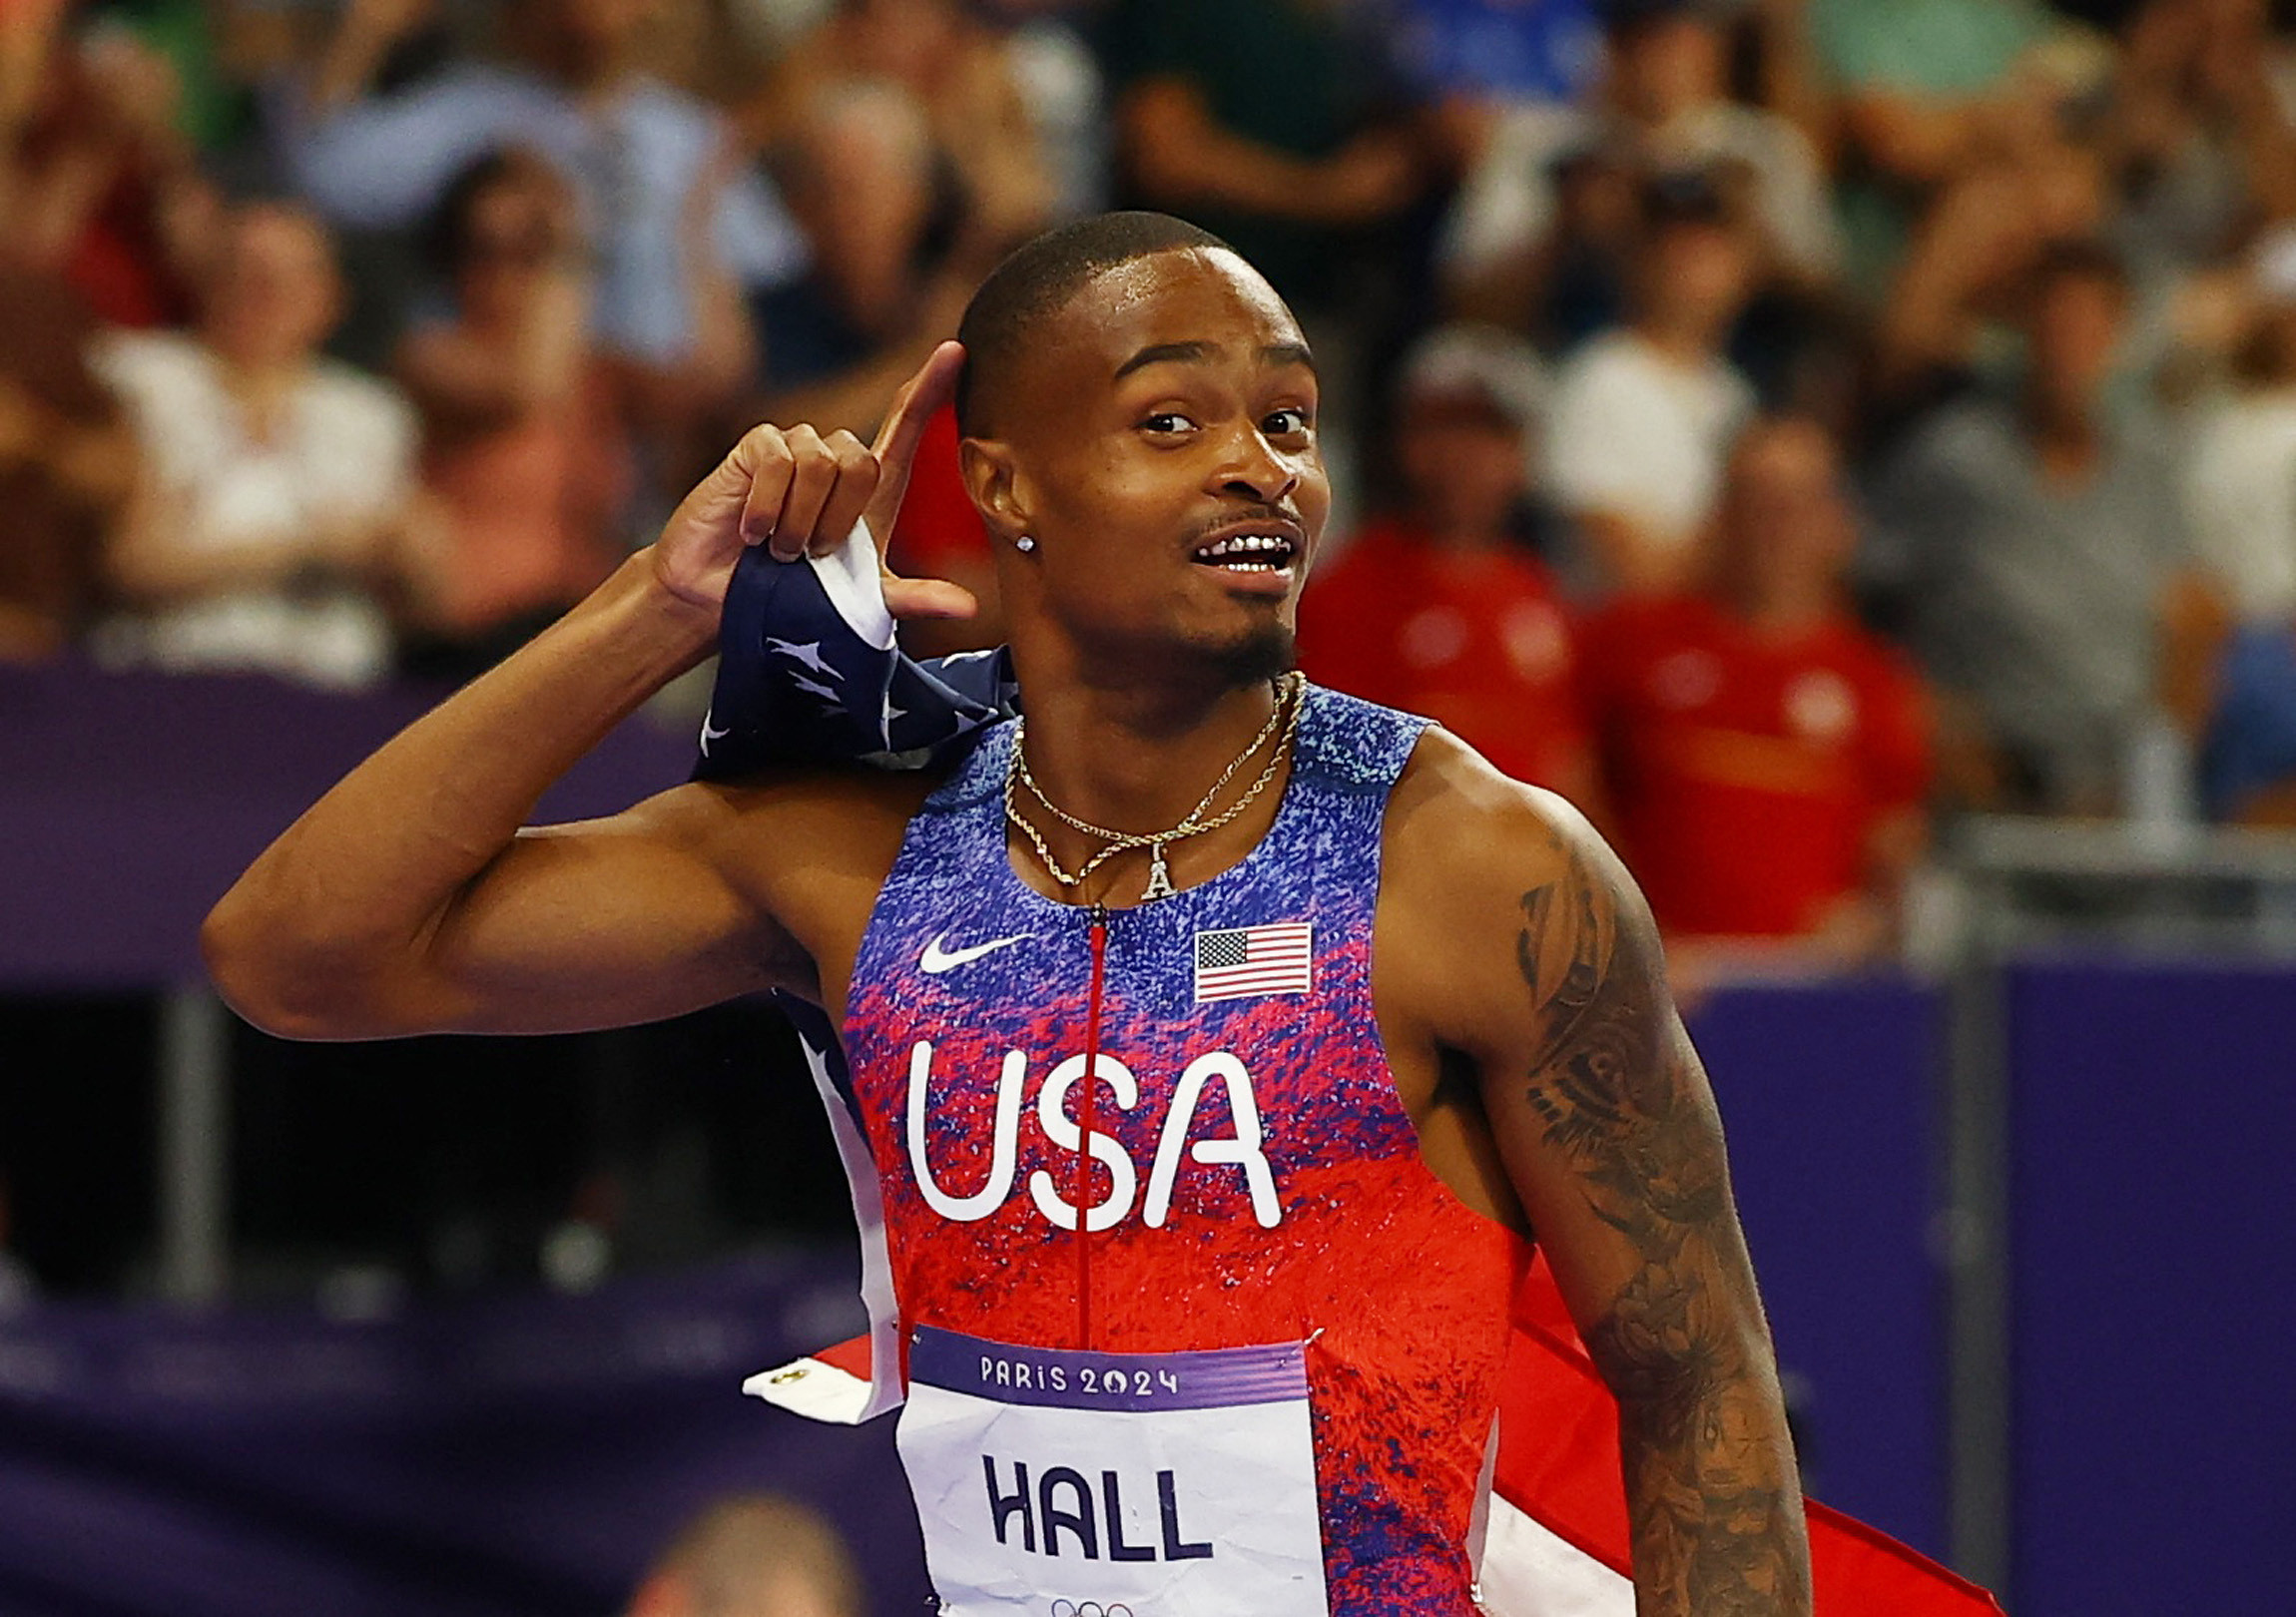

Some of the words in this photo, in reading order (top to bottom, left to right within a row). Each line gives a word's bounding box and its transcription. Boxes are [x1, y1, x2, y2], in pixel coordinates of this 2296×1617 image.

[906, 1039, 1283, 1233] USA
[1079, 1368, 1180, 1396] 2024
[981, 1454, 1214, 1563] HALL
